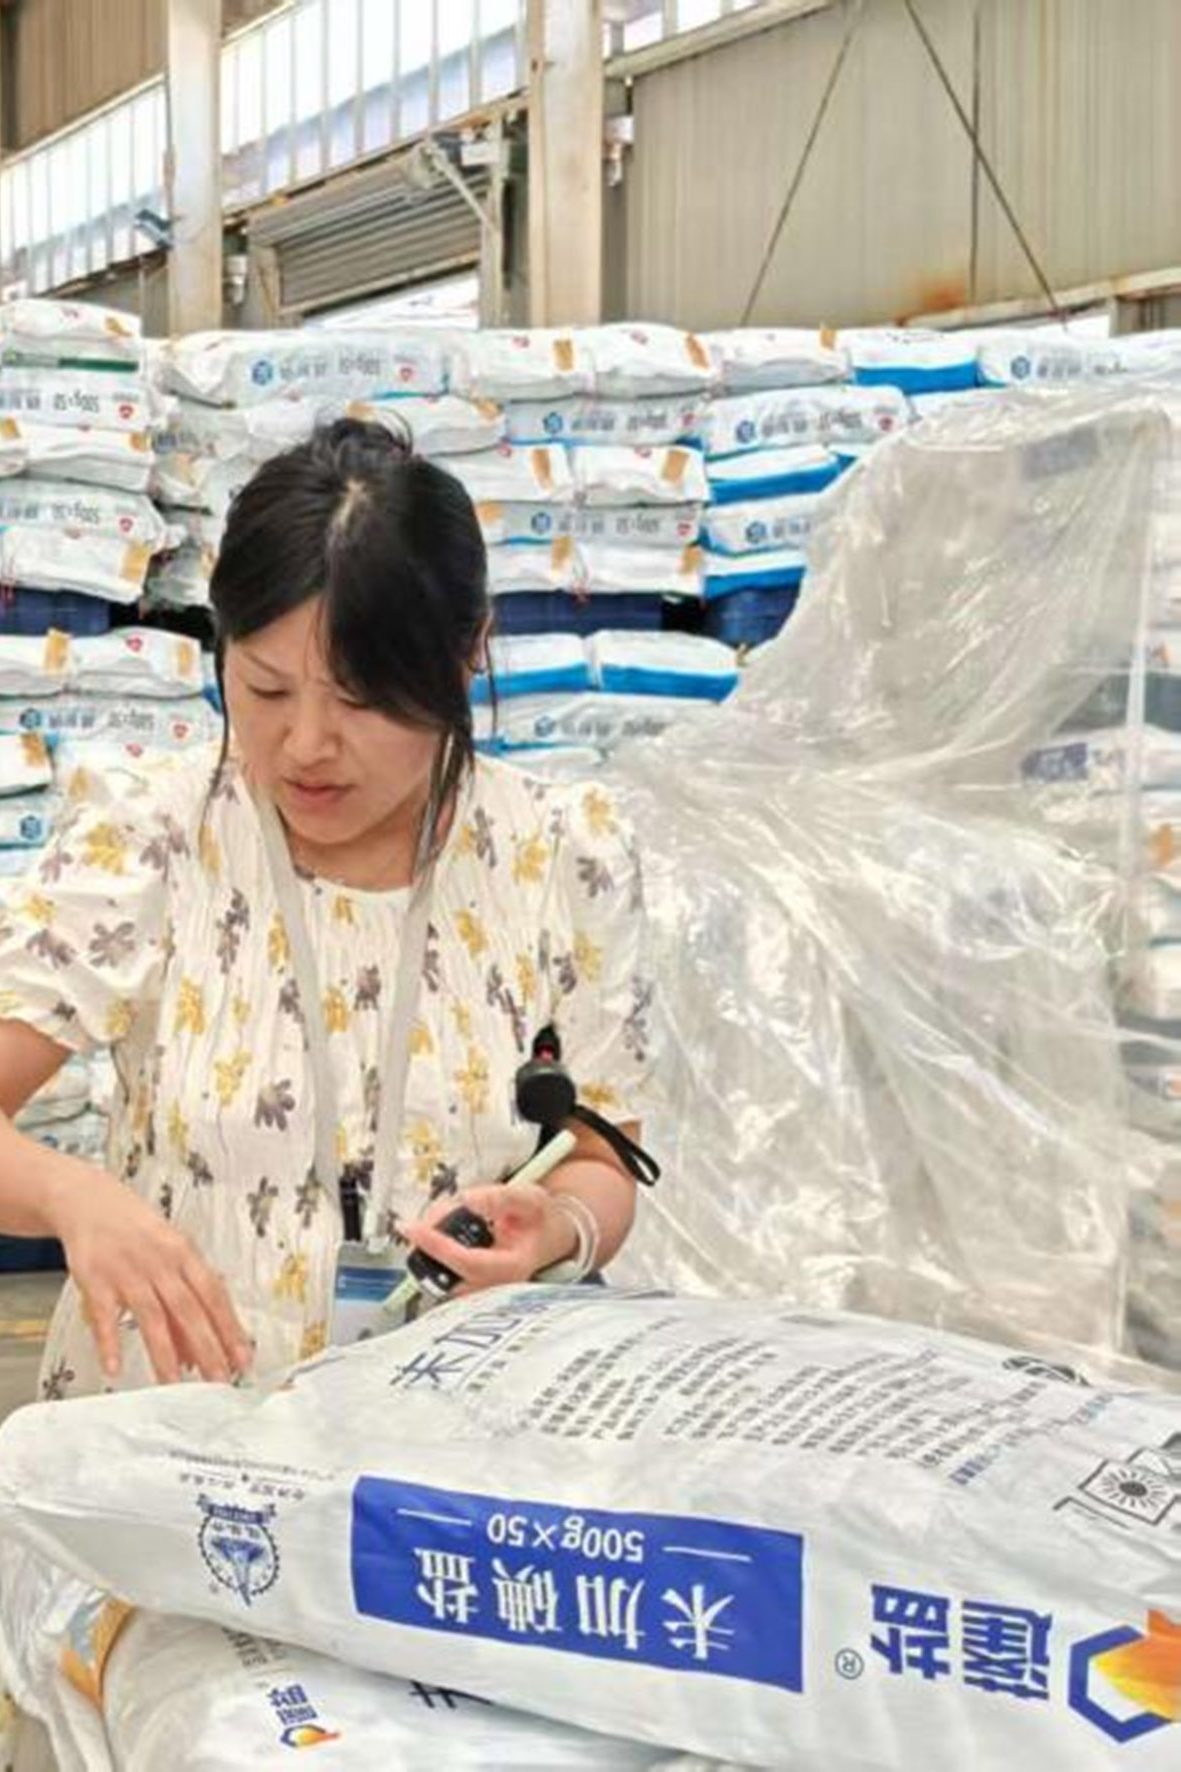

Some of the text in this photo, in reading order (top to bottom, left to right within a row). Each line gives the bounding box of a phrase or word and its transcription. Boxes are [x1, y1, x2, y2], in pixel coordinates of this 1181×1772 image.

[486, 1514, 645, 1563] 500g×50
[413, 1547, 735, 1661] 未加碘盐
